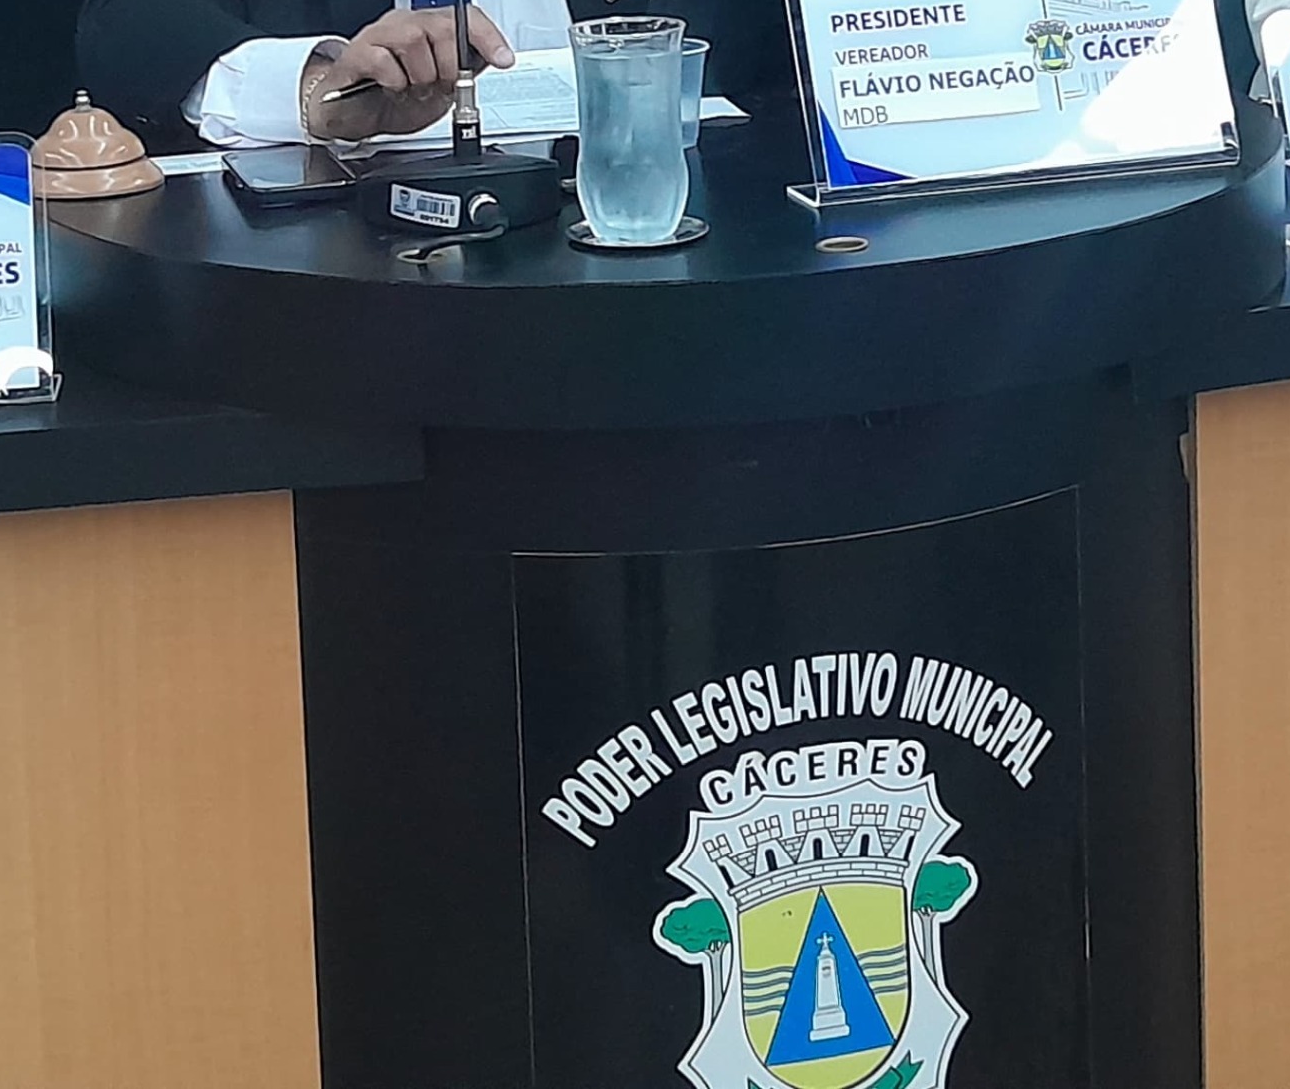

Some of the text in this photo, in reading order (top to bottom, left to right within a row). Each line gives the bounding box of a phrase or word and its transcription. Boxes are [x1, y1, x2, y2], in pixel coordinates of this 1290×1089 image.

[830, 4, 966, 33] PRESIDENTE
[835, 43, 929, 66] VEREADOR
[840, 61, 1035, 98] FLÁVIO NEGAÇÃO
[843, 106, 889, 126] MDB
[541, 652, 1054, 848] PODER LEGISLATIVO MUNICIPAL
[708, 746, 918, 805] CÁCERES
